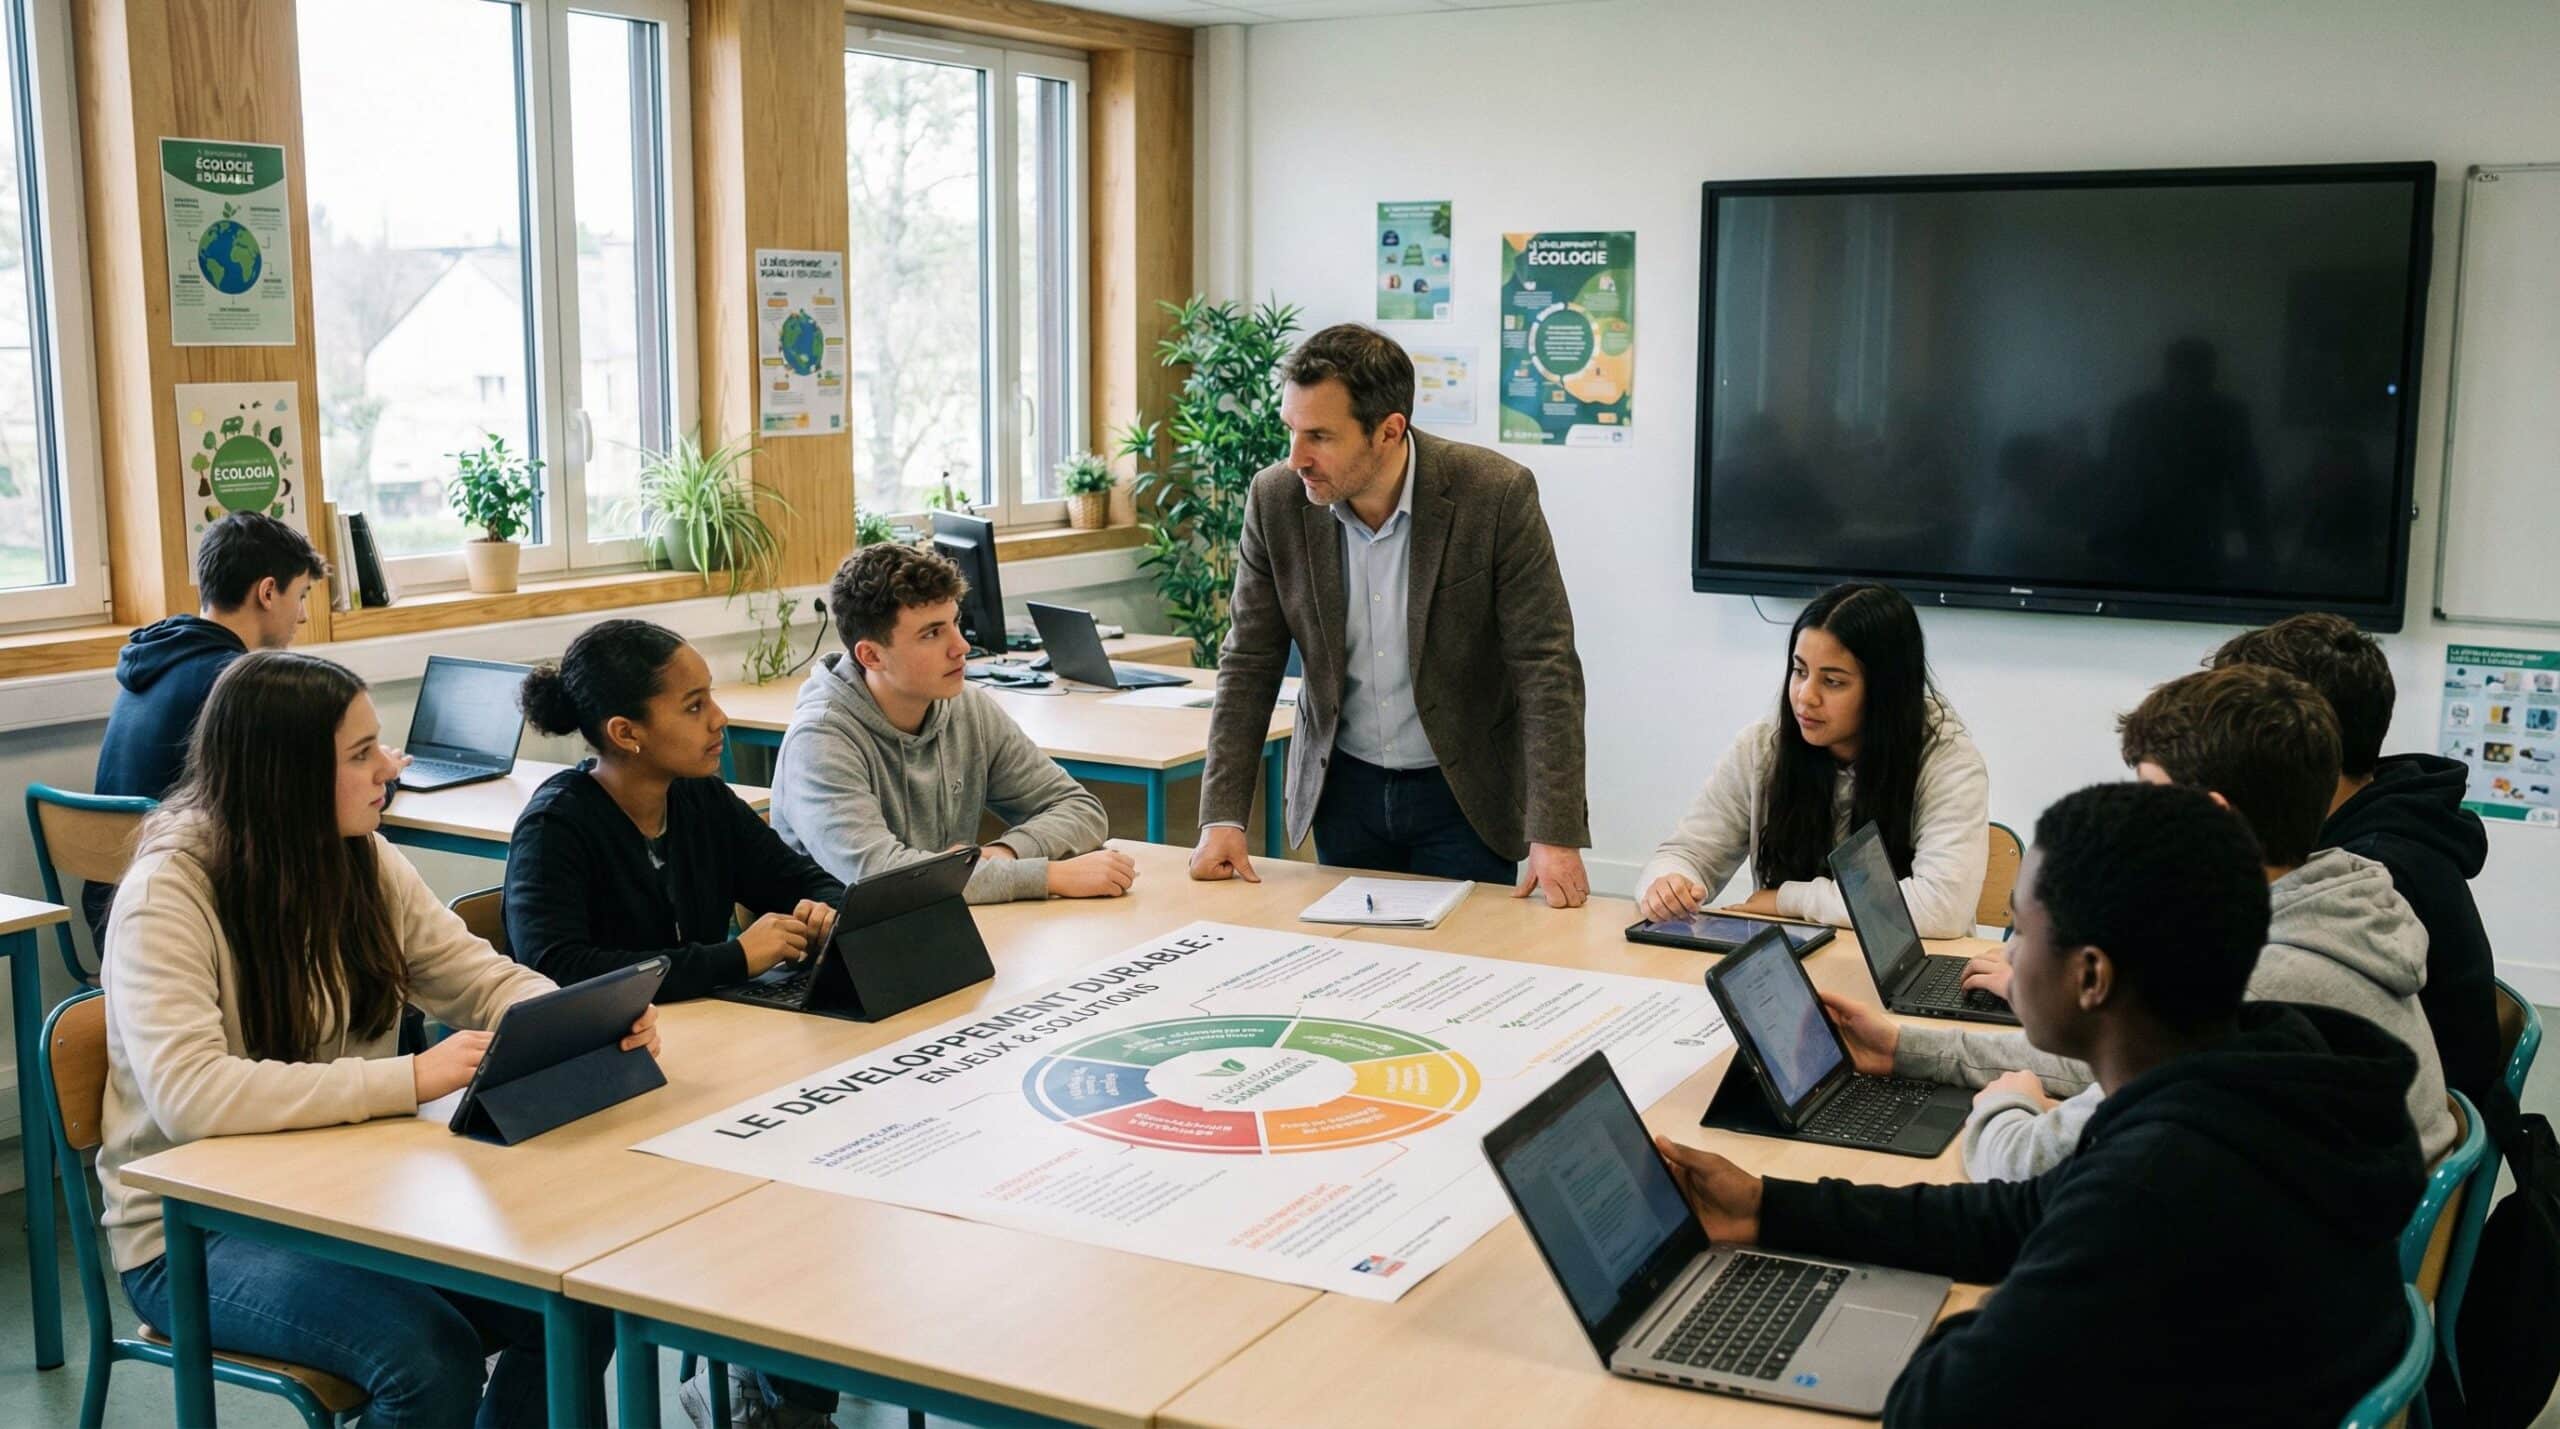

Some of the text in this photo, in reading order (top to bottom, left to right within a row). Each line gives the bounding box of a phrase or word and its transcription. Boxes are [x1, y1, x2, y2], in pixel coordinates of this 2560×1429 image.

[214, 465, 275, 481] ECOLOGIA
[714, 1112, 787, 1140] LE
[771, 991, 1078, 1117] DÉVELOPPEMENT
[1068, 938, 1213, 995] DURABLE
[916, 1040, 1012, 1085] ENJEUX
[1011, 1033, 1041, 1043] &
[1031, 982, 1161, 1034] SOLUTIONS
